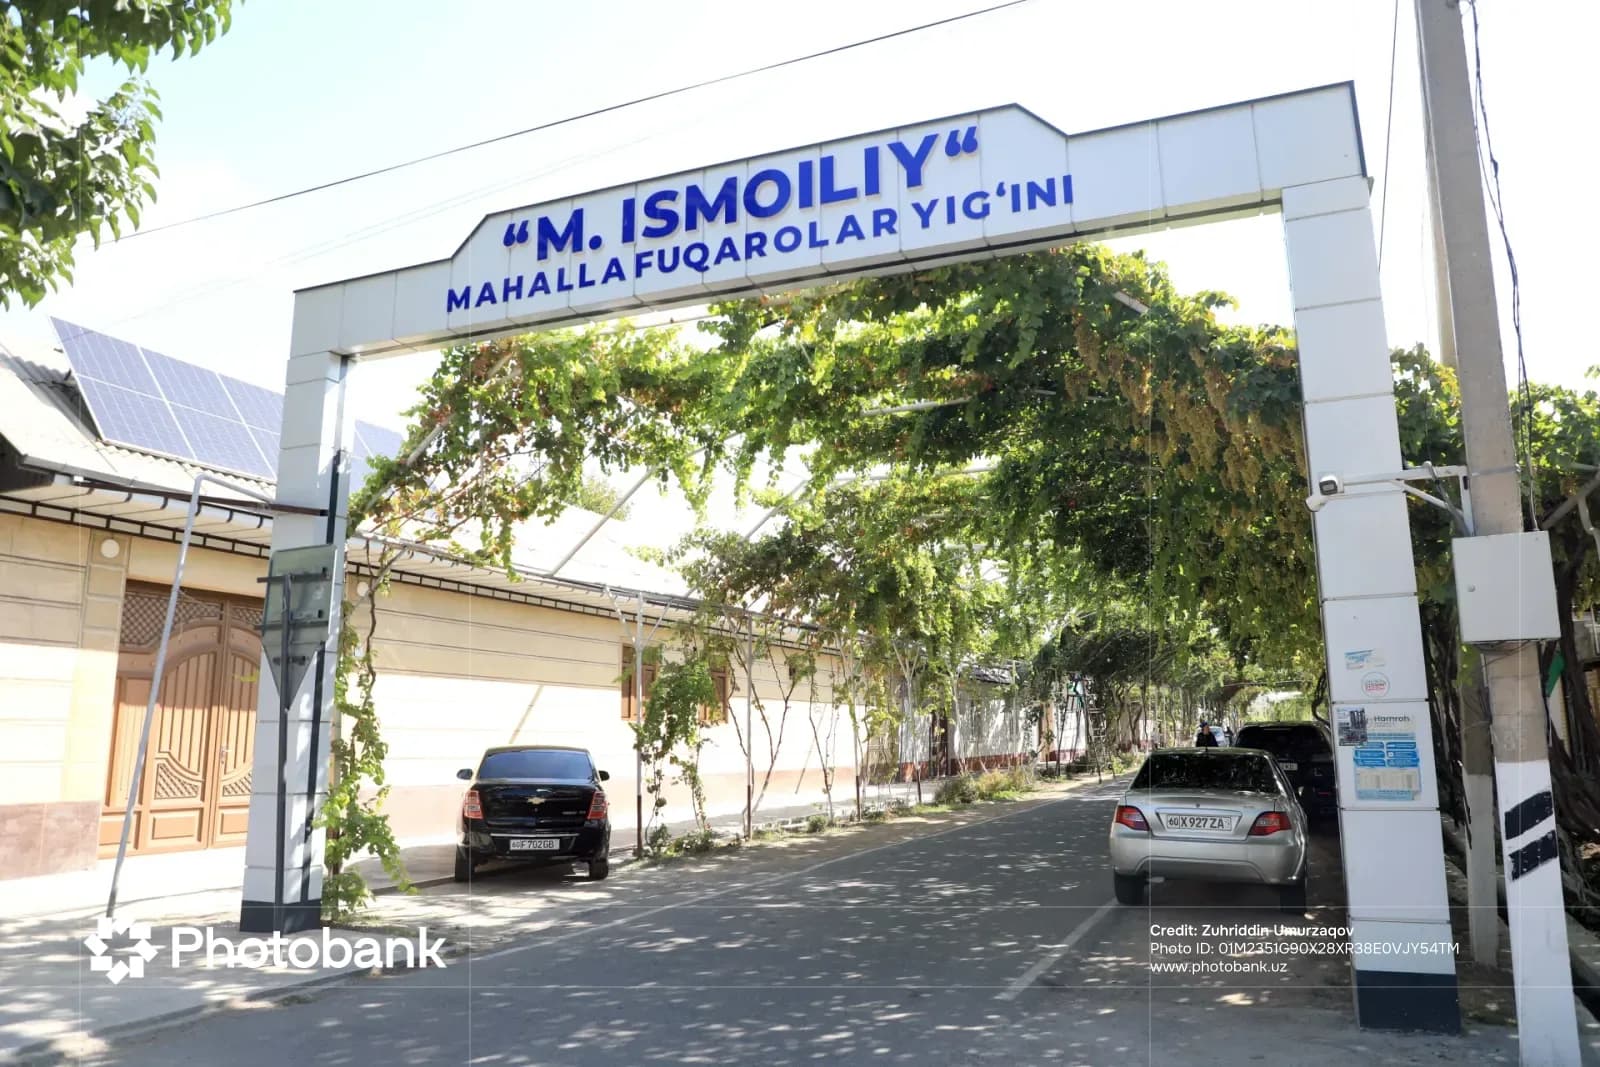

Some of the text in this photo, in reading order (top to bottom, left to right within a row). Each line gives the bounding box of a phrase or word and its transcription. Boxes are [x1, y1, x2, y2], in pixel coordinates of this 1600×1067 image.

[503, 126, 978, 261] “M. ISMOILIY“
[446, 257, 626, 312] MAHALLA
[635, 207, 897, 278] FUQAROLAR
